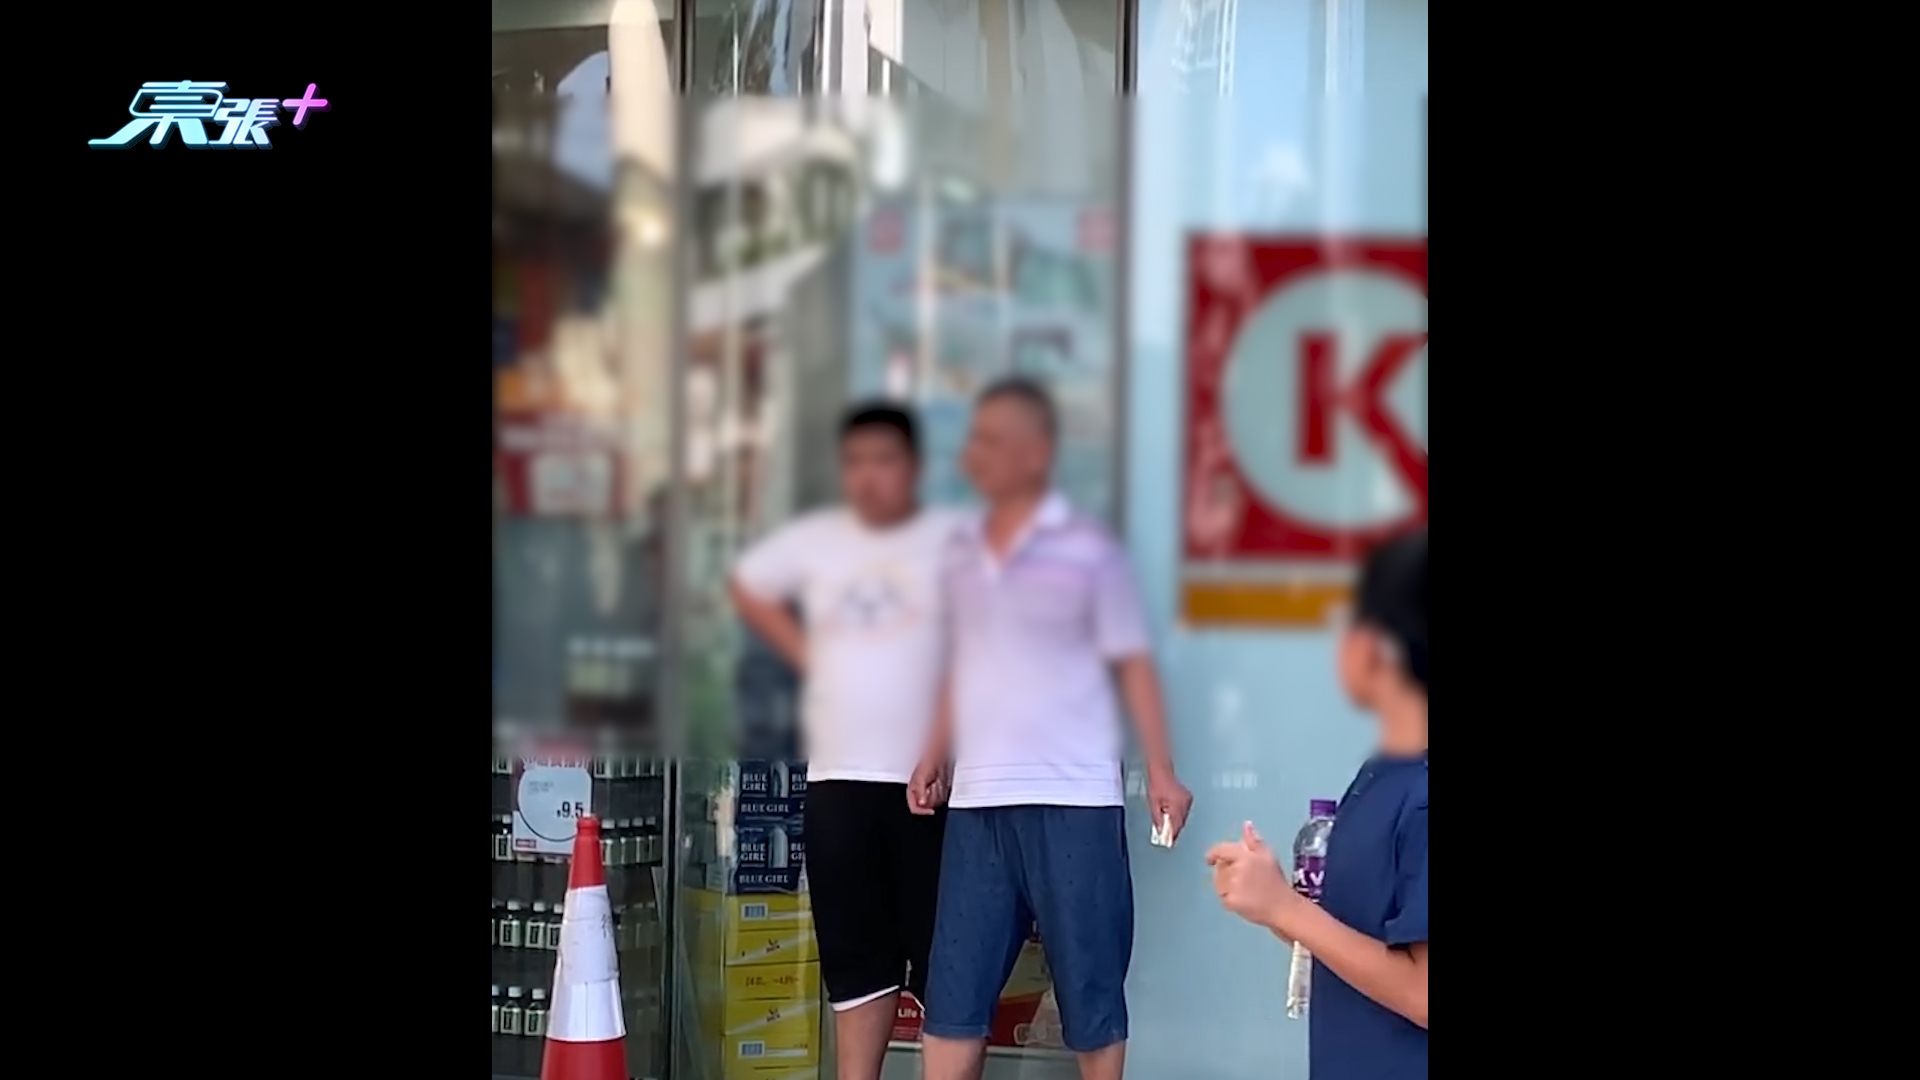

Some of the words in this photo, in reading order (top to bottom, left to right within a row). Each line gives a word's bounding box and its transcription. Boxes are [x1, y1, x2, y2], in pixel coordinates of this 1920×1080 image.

[1297, 331, 1428, 507] K
[742, 773, 768, 782] BLUE
[742, 783, 768, 791] GIRL
[741, 803, 765, 812] BLUE
[766, 803, 790, 812] GIRL
[741, 843, 766, 851] BLUE
[741, 852, 766, 861] GIRL
[740, 875, 764, 883] BLUE
[765, 874, 789, 883] GIRL
[898, 1008, 917, 1018] Life
